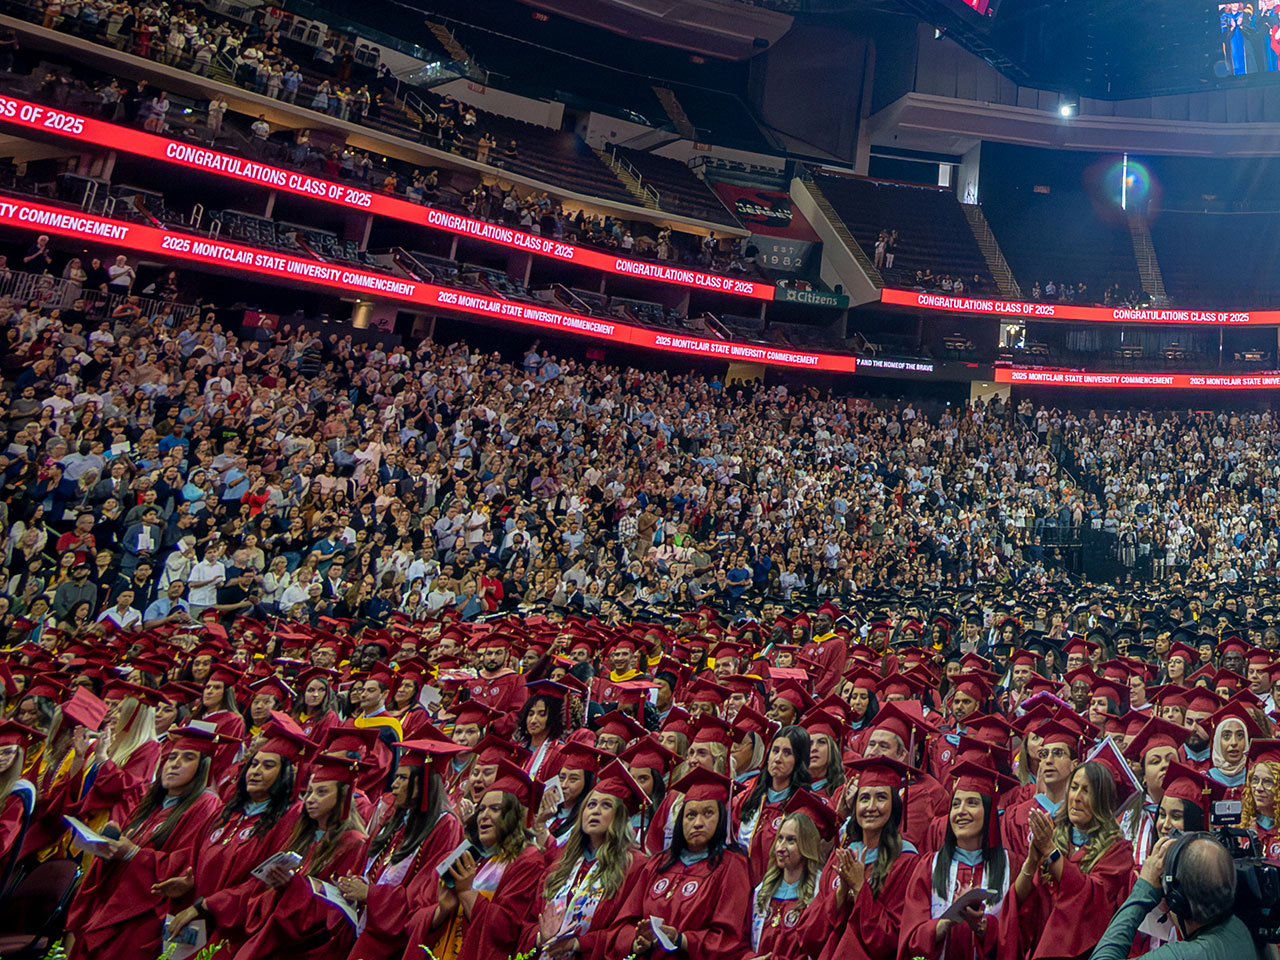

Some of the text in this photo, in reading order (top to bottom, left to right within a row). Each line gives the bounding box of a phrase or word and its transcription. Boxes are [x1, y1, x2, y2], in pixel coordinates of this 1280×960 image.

[20, 102, 44, 123] OF
[44, 112, 84, 134] 2025
[166, 143, 372, 208] CONGRATULATIONS CLASS OF 2025
[18, 208, 128, 240] COMMENCEMENT
[738, 208, 793, 220] JERSEY
[428, 211, 574, 258] CONGRATULATIONS CLASS OF 2025
[162, 236, 415, 296] 2025 MONTCLAIR STATE UNIVERSITY COMMENCEMENT
[763, 254, 802, 266] 1982
[616, 260, 753, 294] CONGRATULATIONS CLASS OF 2025
[438, 292, 615, 335] 2025 MONTCLAIR STATE UNIVERSITY COMMENCEMENT
[798, 292, 838, 306] Citizens
[918, 294, 1054, 315] CONGRATULATIONS CLASS OF 2025
[1113, 310, 1249, 322] CONGRATULATIONS CLASS OF 2025
[655, 336, 818, 366] 2025 MONTCLAIR STATE UNIVERSITY COMMENCEMENT
[873, 360, 882, 368] THE
[1012, 372, 1173, 384] 2025 MONTCLAIR STATE UNIVERSITY COMMENCEMENT
